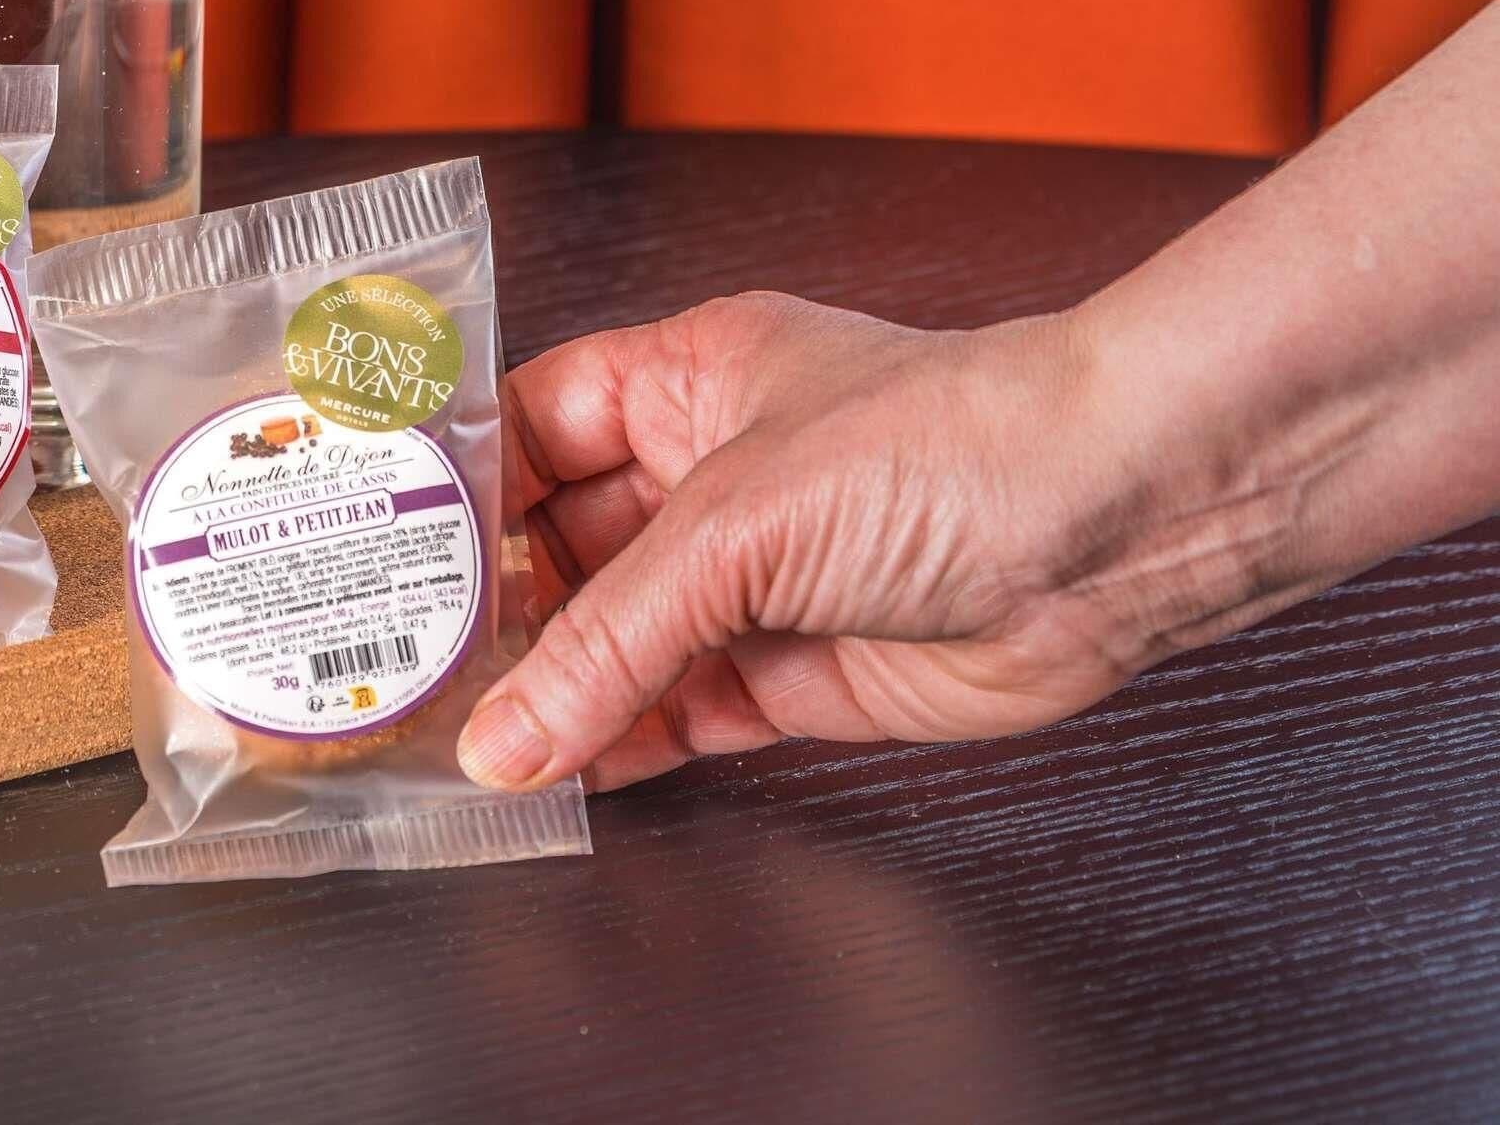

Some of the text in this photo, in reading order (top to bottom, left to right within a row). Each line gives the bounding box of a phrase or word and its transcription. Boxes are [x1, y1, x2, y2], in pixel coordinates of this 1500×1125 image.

[320, 290, 359, 313] UNE
[321, 321, 427, 376] BONS
[320, 396, 392, 424] MERCURE
[181, 445, 395, 501] Nonnette de Dijon
[230, 486, 319, 514] CONFITURE
[324, 481, 345, 496] DE
[348, 471, 398, 491] CASSIS
[213, 498, 388, 553] MULOT & PETITJEAN
[271, 675, 300, 690] 30g
